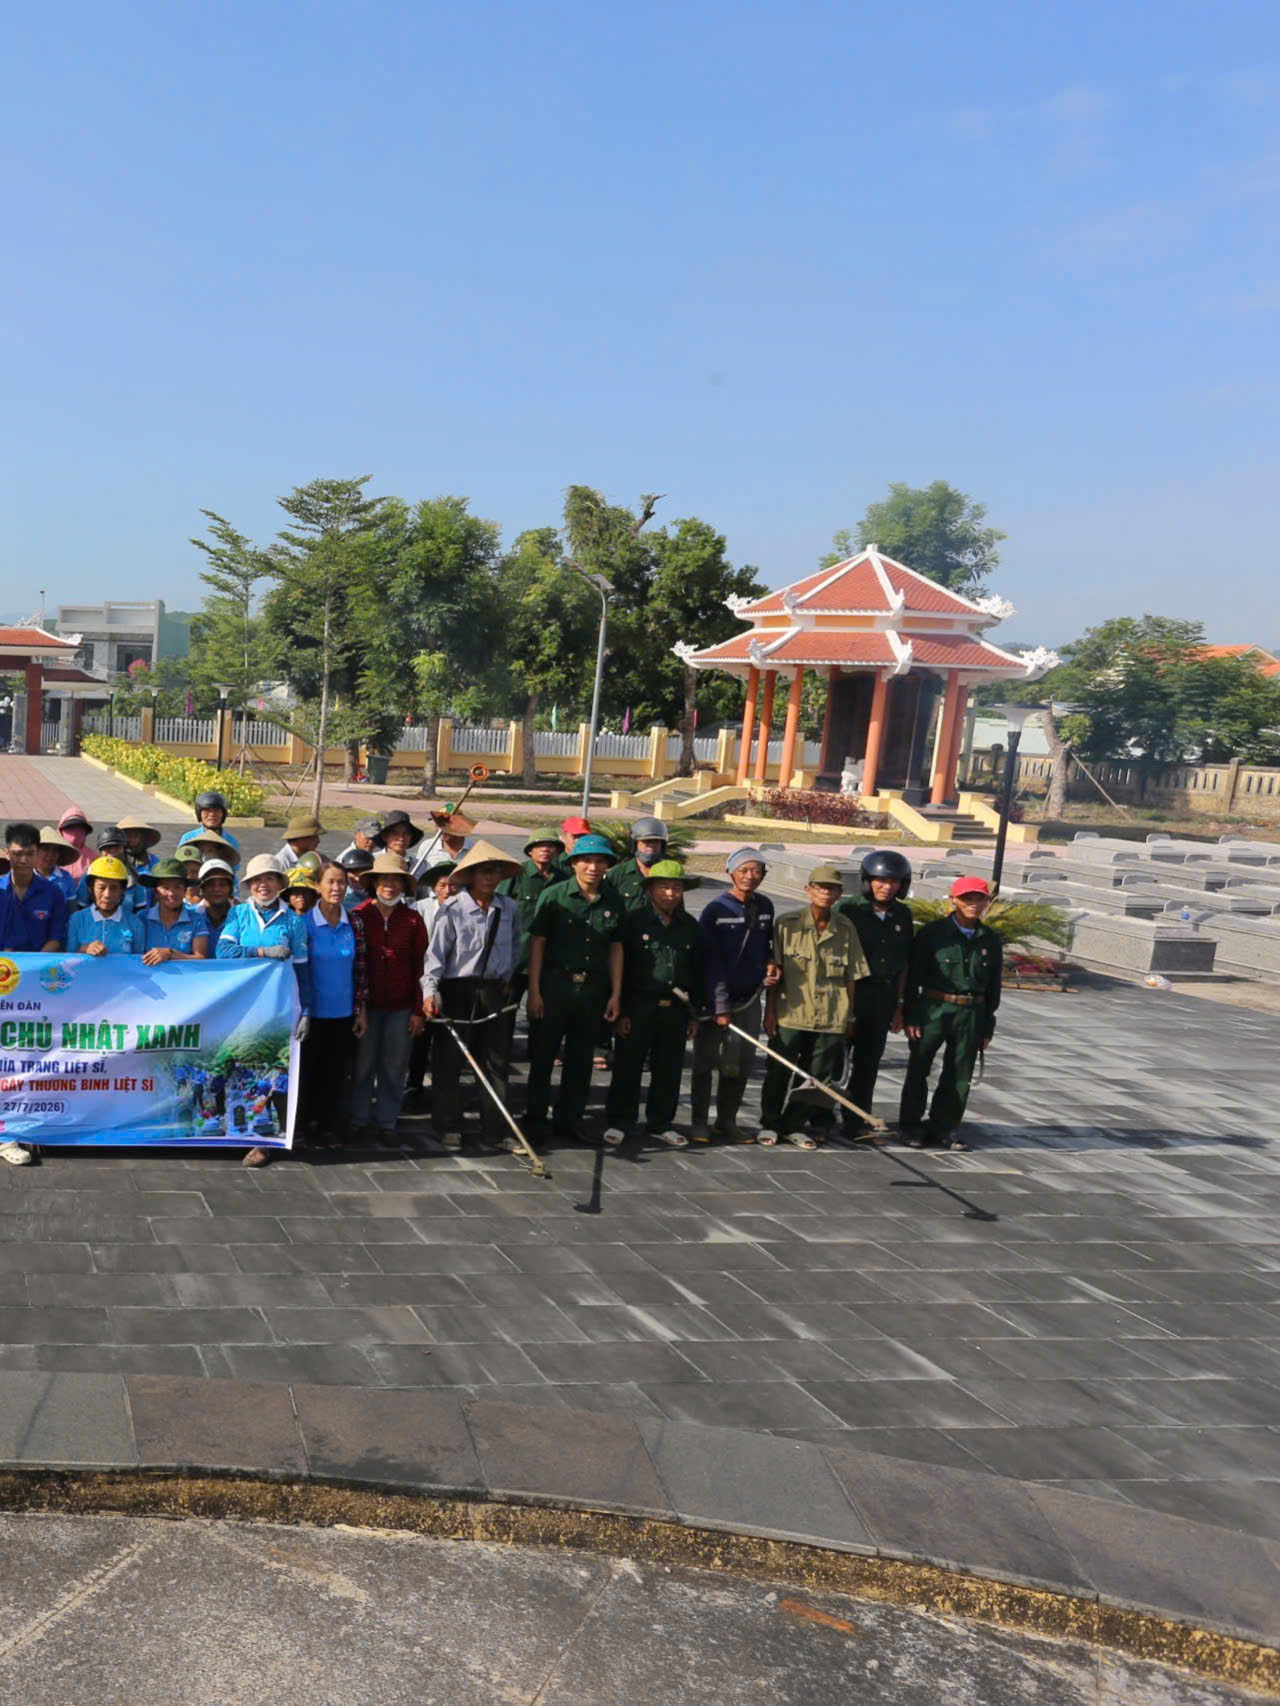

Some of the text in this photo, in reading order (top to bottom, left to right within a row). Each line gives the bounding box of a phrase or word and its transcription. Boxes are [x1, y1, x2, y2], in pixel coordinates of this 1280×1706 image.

[0, 1016, 52, 1048] CHỦ
[62, 1019, 128, 1055] NHẬT
[136, 1024, 200, 1049] XANH
[20, 1060, 60, 1073] TRANG
[64, 1060, 88, 1075] LIỆT
[81, 1079, 109, 1091] BINH
[114, 1076, 137, 1093] LIỆT
[3, 1101, 64, 1113] 27/7/2026)
